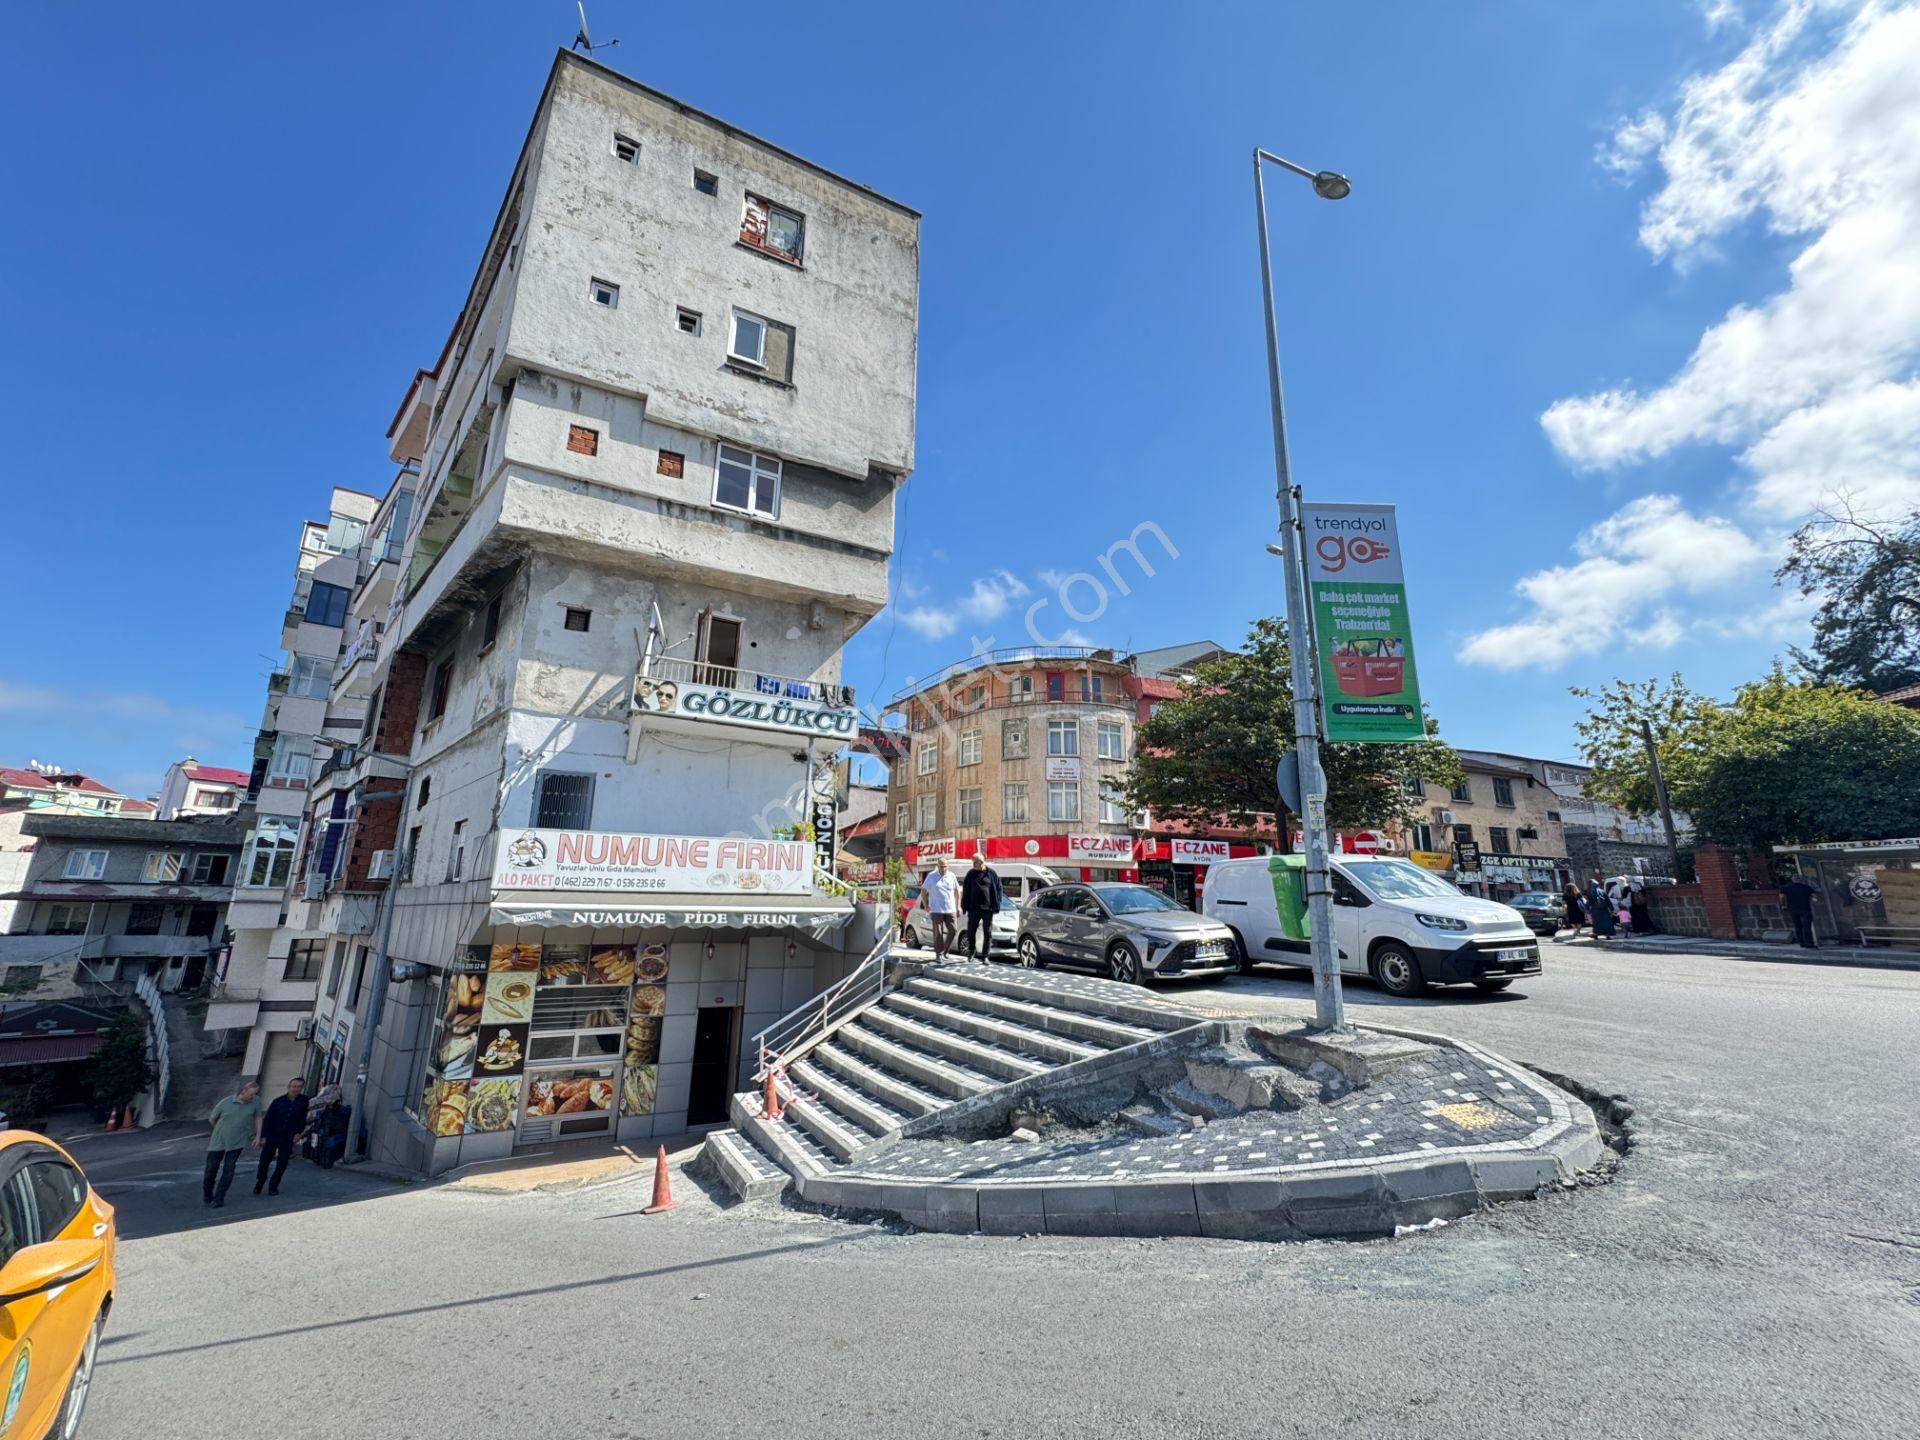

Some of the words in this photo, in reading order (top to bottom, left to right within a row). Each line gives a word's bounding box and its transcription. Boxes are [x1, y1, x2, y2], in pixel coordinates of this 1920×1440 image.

[1314, 516, 1386, 533] trendyol
[1316, 536, 1390, 572] go
[1319, 591, 1345, 603] Daha
[556, 833, 710, 868] NUMUNE
[716, 841, 804, 871] FIRINI
[917, 842, 954, 857] ECZANE
[1071, 837, 1131, 852] ECZANE
[1175, 842, 1227, 855] ECZANE
[556, 864, 588, 872] Yavuzlar
[1532, 857, 1554, 869] LENS
[497, 873, 518, 886] ALO
[520, 873, 555, 887] PAKET
[554, 876, 561, 886] 0
[562, 876, 582, 887] (462)
[582, 877, 596, 887] 229
[596, 878, 603, 887] 71
[622, 878, 636, 888] 536
[636, 878, 649, 888] 235
[571, 912, 667, 925] NUMUNE
[683, 910, 728, 925] PİDE
[742, 913, 798, 926] FIRINI
